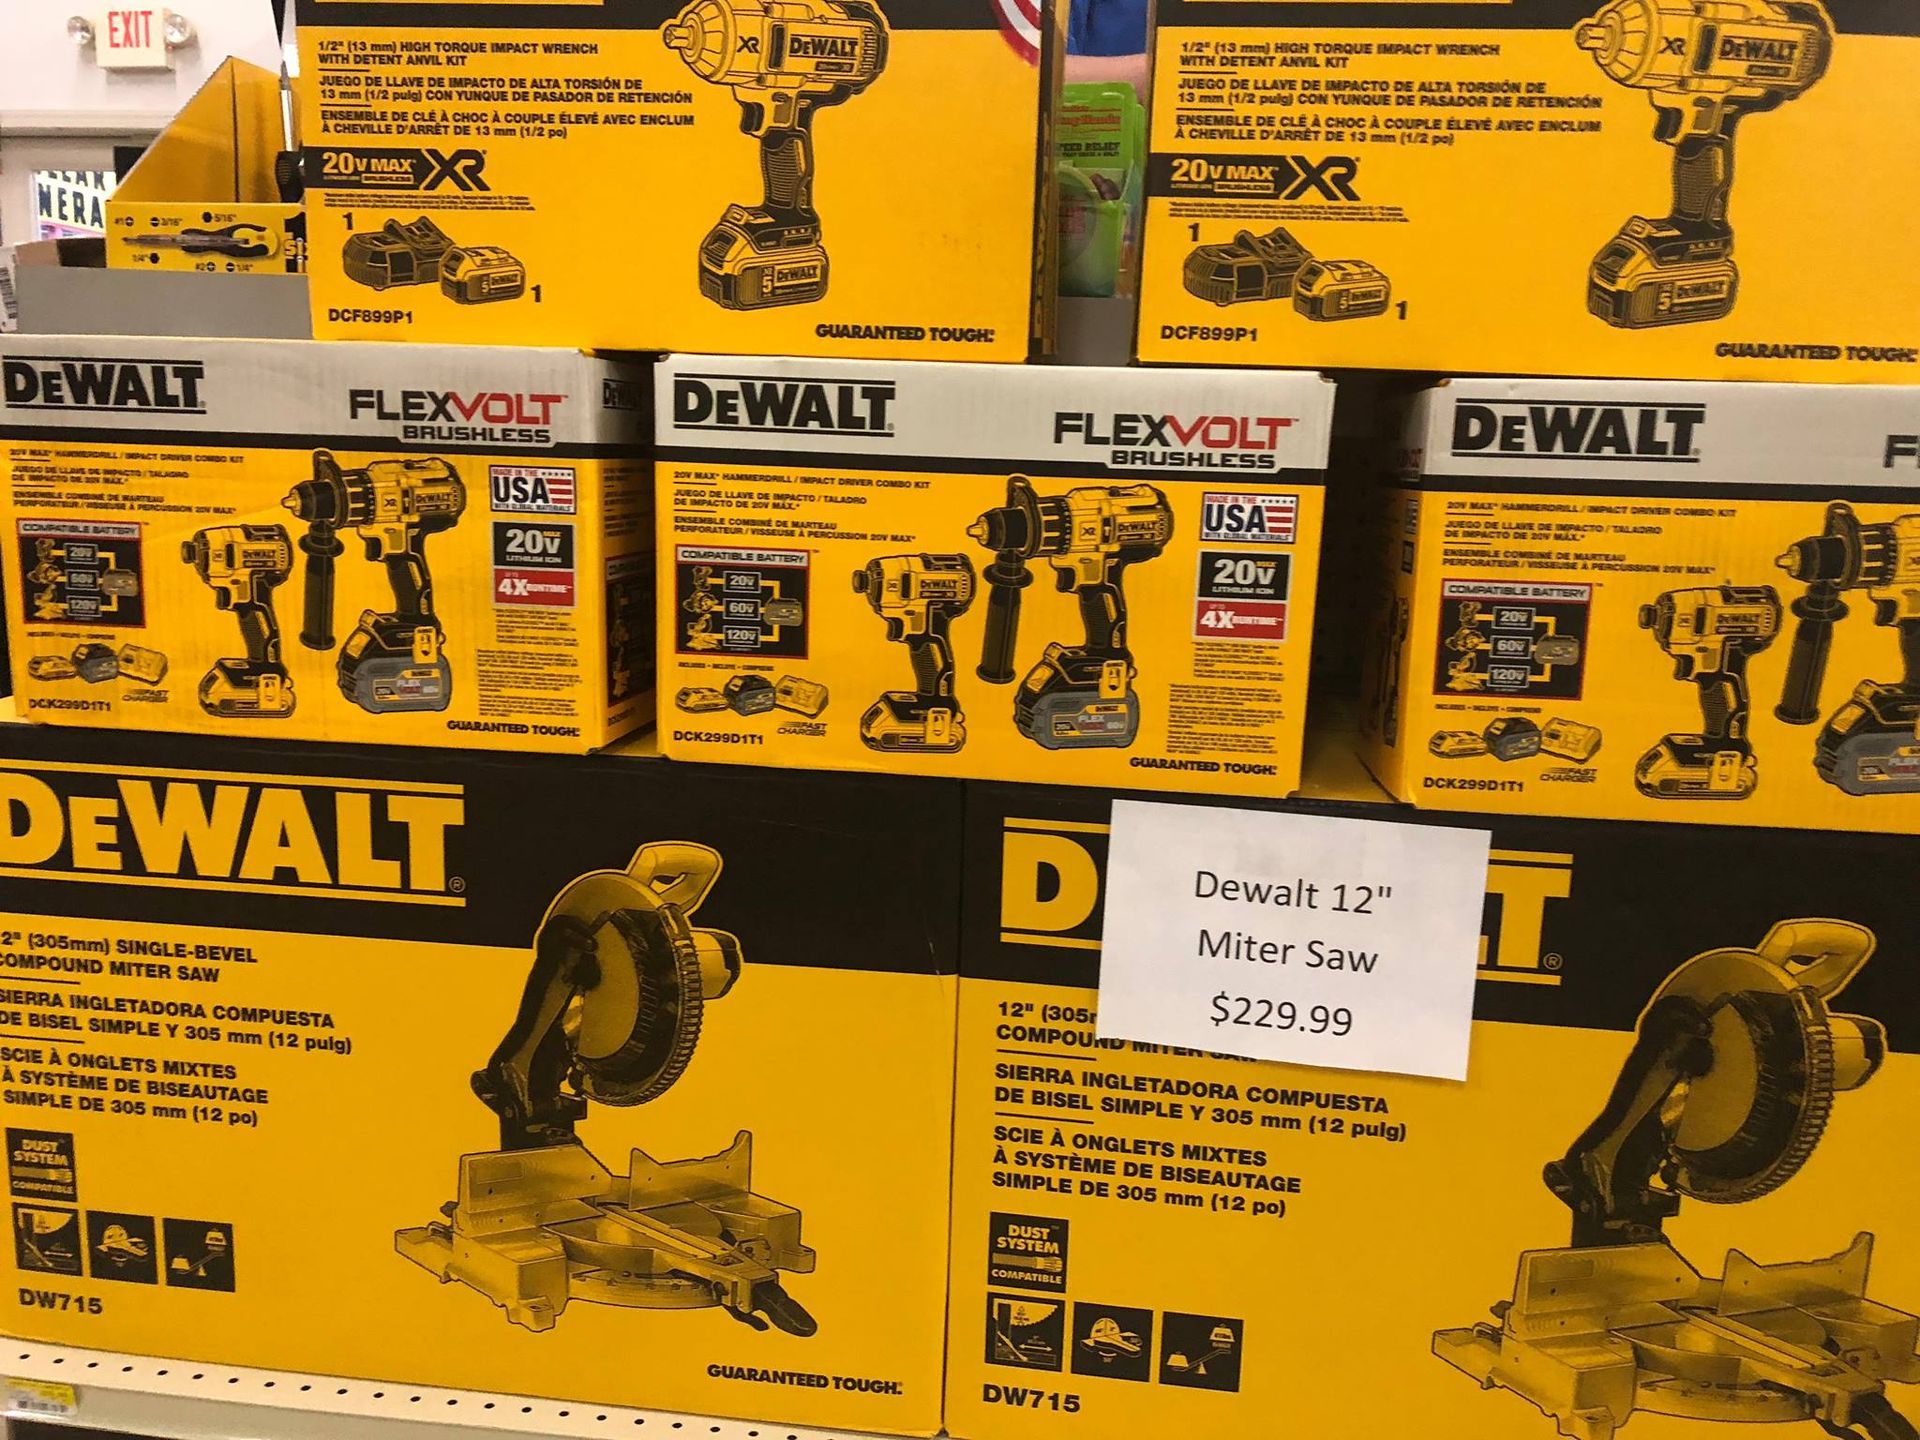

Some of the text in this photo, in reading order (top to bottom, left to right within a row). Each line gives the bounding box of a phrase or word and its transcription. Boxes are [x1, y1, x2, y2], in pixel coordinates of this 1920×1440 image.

[108, 10, 152, 48] EXIT
[365, 88, 388, 101] (1/2
[328, 308, 412, 323] DCF899P1
[816, 324, 924, 340] GUARANTEED
[1161, 326, 1257, 342] DCF899P1
[1715, 343, 1840, 360] GUARANTEED
[350, 389, 562, 426] FLEXVOLT
[403, 426, 550, 443] BRUSHLESS
[1054, 412, 1292, 450] FLEXVOLT
[1111, 450, 1276, 469] BRUSHLESS
[493, 476, 550, 504] USA
[1206, 504, 1266, 533] USA
[447, 720, 528, 735] GUARANTEED
[1130, 757, 1219, 772] GUARANTEED
[1195, 870, 1391, 914] Dewalt 12"
[28, 933, 110, 955] (305mm)
[116, 939, 257, 962] SINGLE-BEVEL
[1198, 929, 1378, 973] Miter Saw
[109, 961, 171, 979] MITER
[177, 965, 219, 982] SAW
[998, 1001, 1033, 1017] 12"
[1210, 990, 1351, 1036] $229.99
[995, 1063, 1388, 1113] SIERRA INGLETADORA COMPUESTA
[995, 1086, 1406, 1142] DE BISEL SIMPLE Y 305 mm (12 pulg)
[993, 1125, 1042, 1144] SCIE
[1072, 1133, 1174, 1157] ONGLETS
[1182, 1144, 1266, 1166] MIXTES
[1014, 1150, 1115, 1174] SYSTÈME
[1123, 1161, 1152, 1178] DE
[1160, 1165, 1300, 1193] BISEAUTAGE
[992, 1171, 1285, 1218] SIMPLE DE 305 mm (12 po)
[1008, 1224, 1050, 1240] DUST
[997, 1237, 1059, 1254] SYSTEM
[991, 1269, 1062, 1284] COMPATIBLE
[19, 1288, 103, 1314] DW715
[707, 1364, 829, 1388] GUARANTEED
[983, 1384, 1080, 1413] DW715
